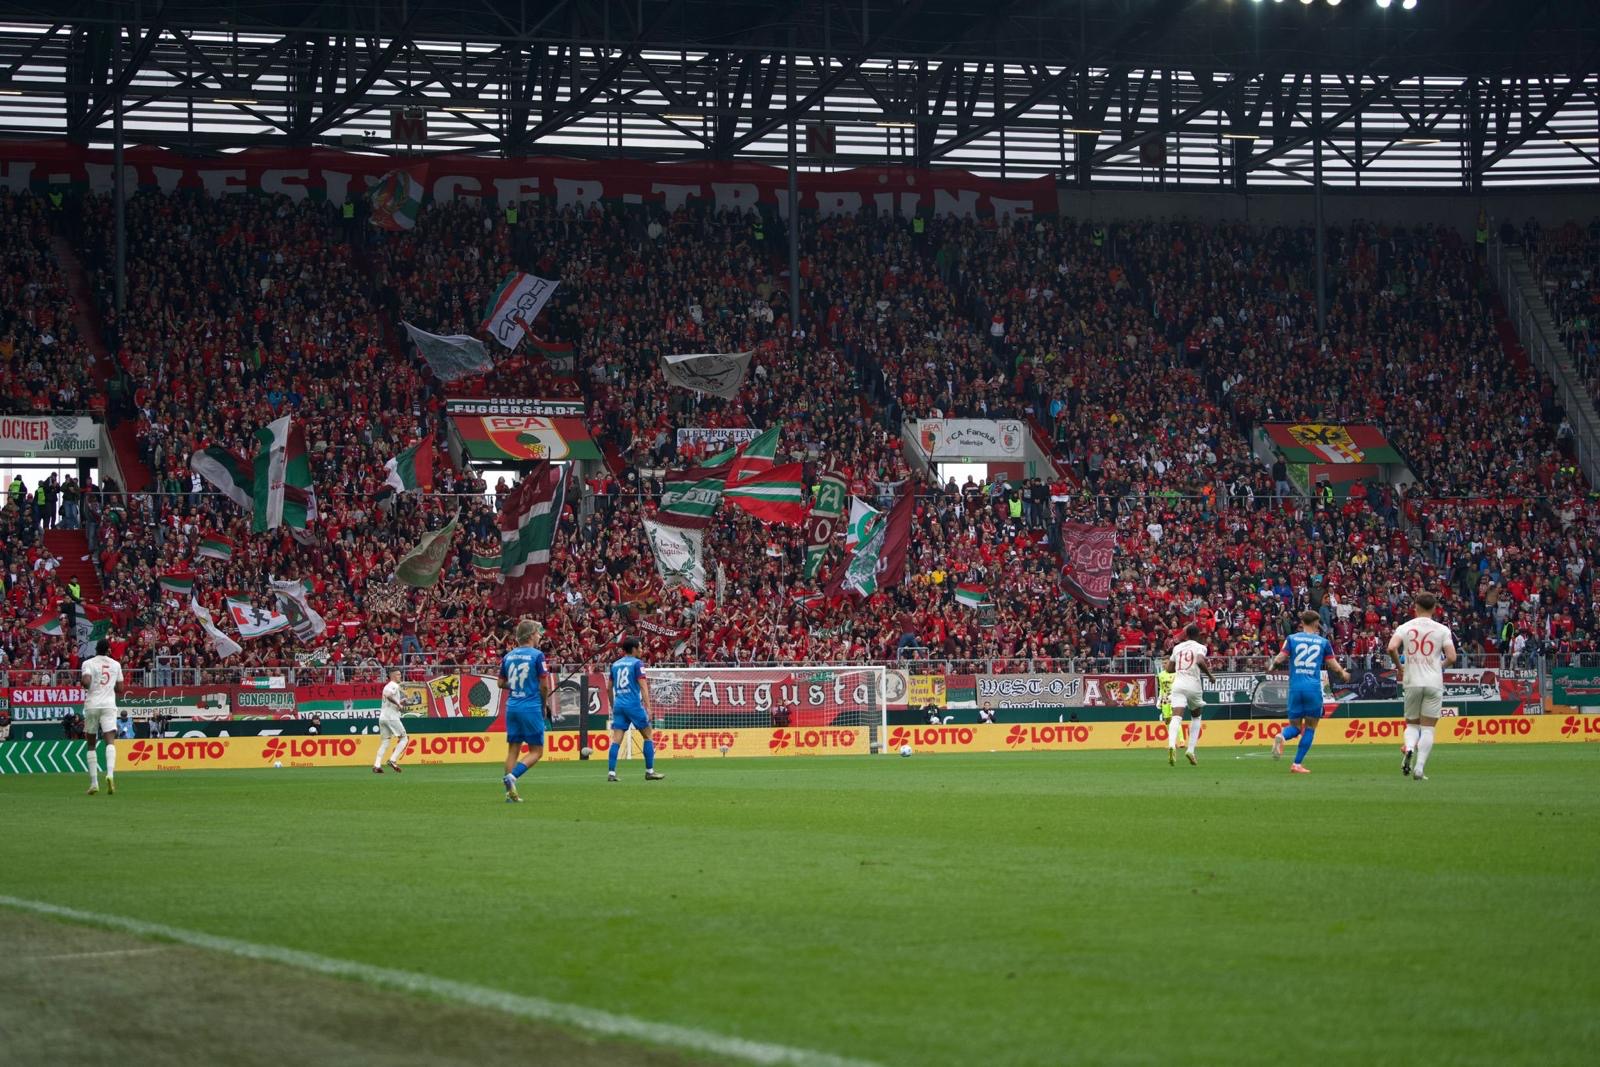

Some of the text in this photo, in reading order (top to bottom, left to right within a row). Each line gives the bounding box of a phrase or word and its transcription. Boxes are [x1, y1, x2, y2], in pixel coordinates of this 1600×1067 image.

[808, 127, 833, 154] N
[454, 405, 577, 415] FUGGERSTADT
[0, 418, 49, 440] OCKER
[491, 418, 546, 429] FCA
[946, 428, 996, 445] FCA Fanclub
[1406, 629, 1435, 657] 36
[1178, 650, 1194, 671] 19
[1294, 649, 1322, 674] 22
[100, 665, 111, 684] 5
[617, 667, 629, 689] 18
[13, 689, 88, 703] SCHWABE
[238, 693, 294, 706] CONCORDIA
[693, 676, 870, 711] Augusta
[14, 707, 75, 720] UNITED
[914, 727, 972, 746] LOTTO
[1032, 726, 1088, 743] LOTTO
[1478, 718, 1534, 736] LOTTO
[291, 738, 356, 758] LOTTO
[421, 737, 484, 755] LOTTO
[673, 732, 734, 750] LOTTO
[795, 729, 855, 748] LOTTO
[157, 741, 224, 760] LOTTO
